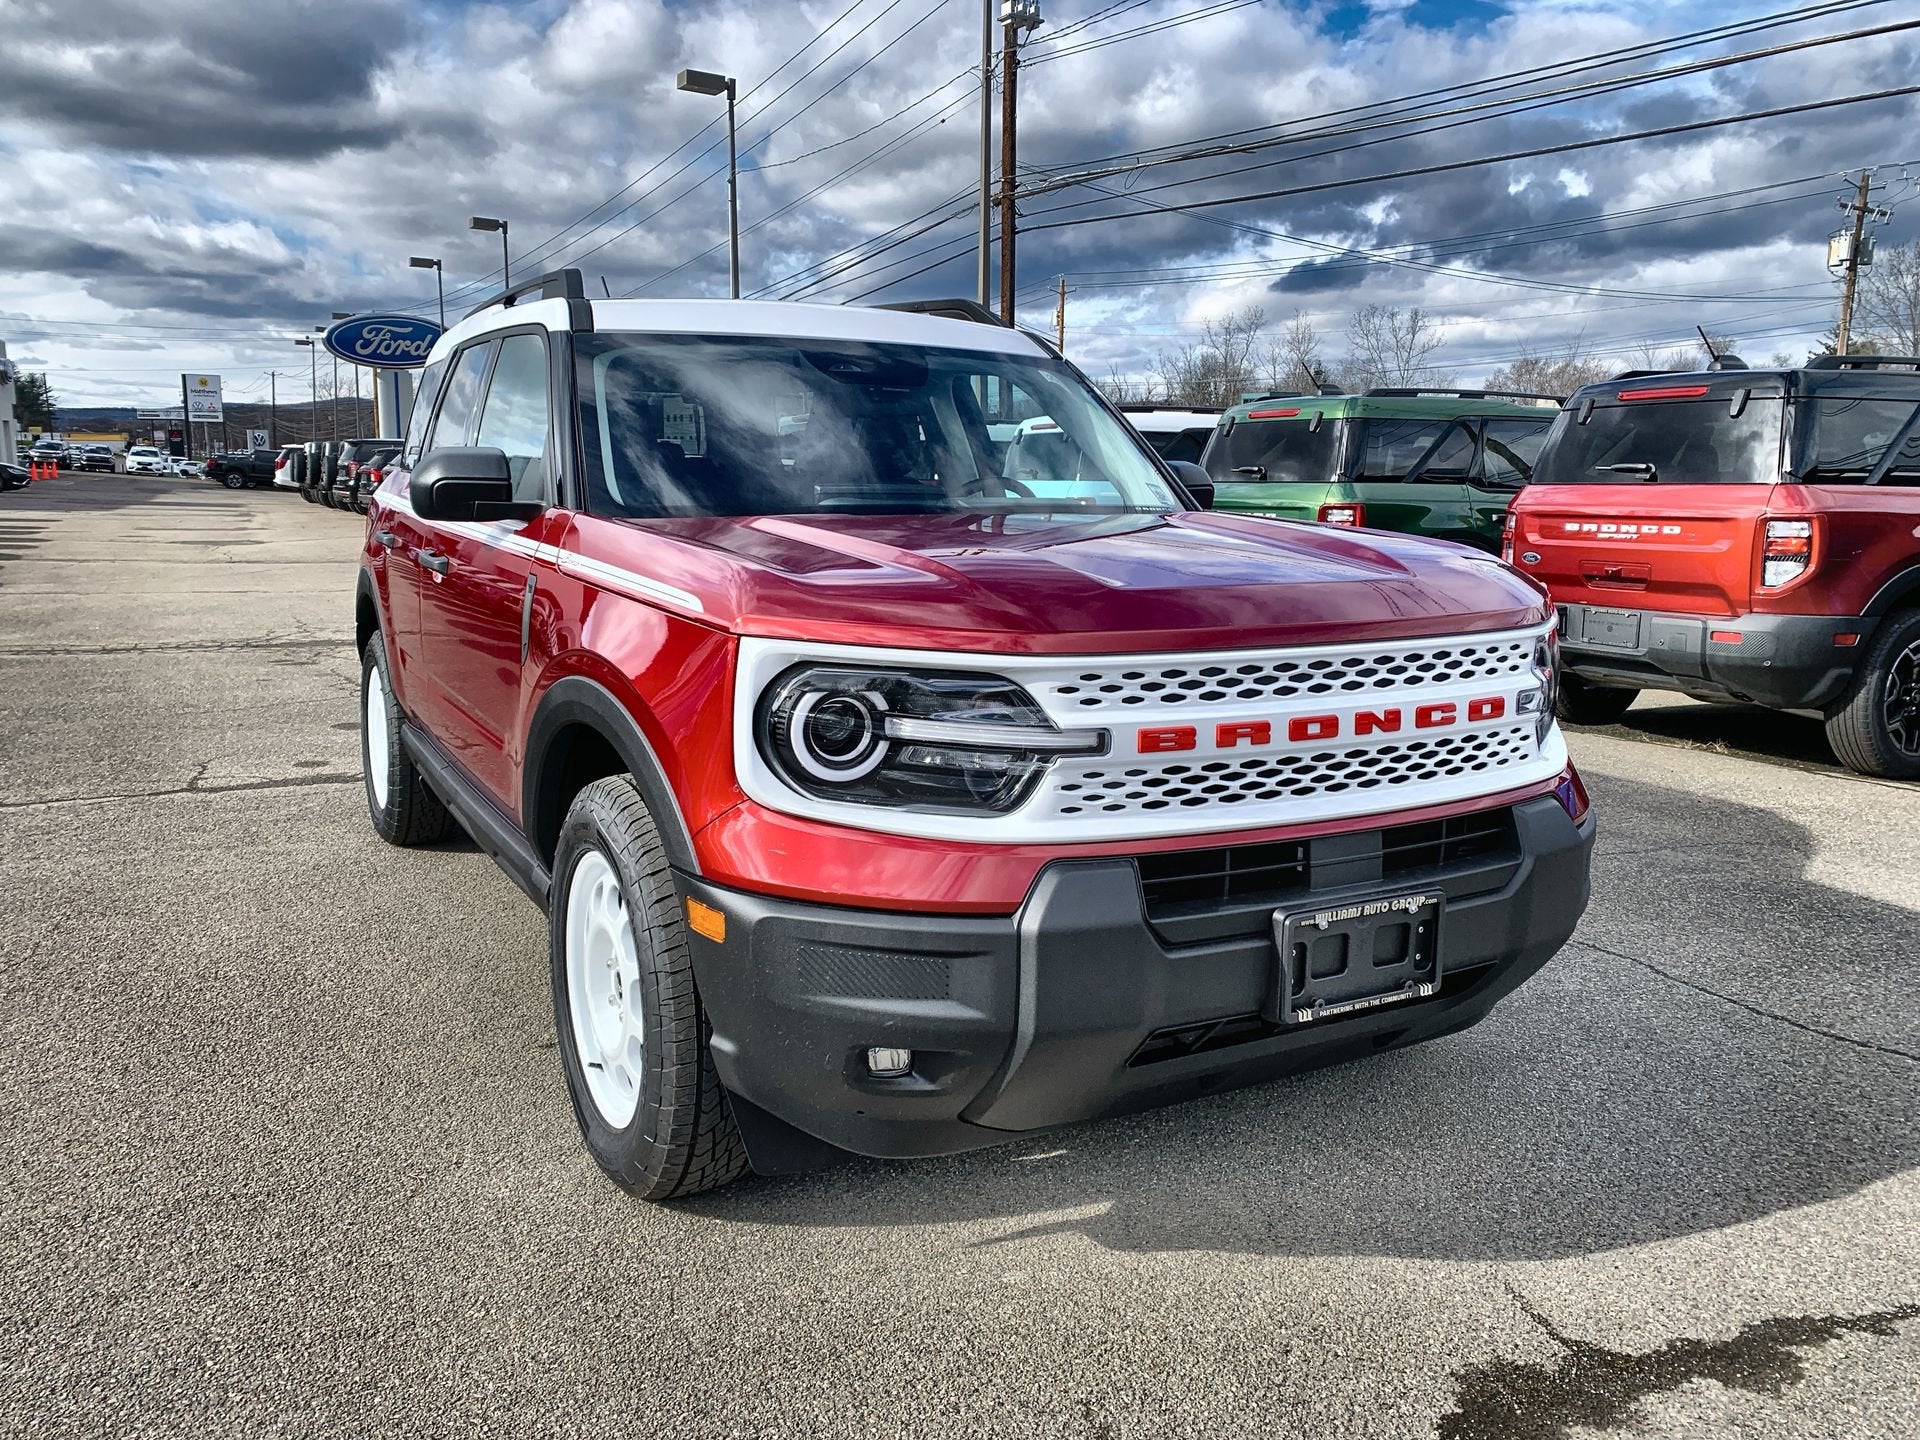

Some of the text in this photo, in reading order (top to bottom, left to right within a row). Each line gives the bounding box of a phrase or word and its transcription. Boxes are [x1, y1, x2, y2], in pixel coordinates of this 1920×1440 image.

[355, 324, 433, 356] Ford
[1564, 523, 1682, 534] BRONCO
[1138, 695, 1506, 754] BRONCO
[1363, 902, 1389, 916] AUTO
[1319, 991, 1413, 1017] PARTNERING WITH THE COMMUNITY
